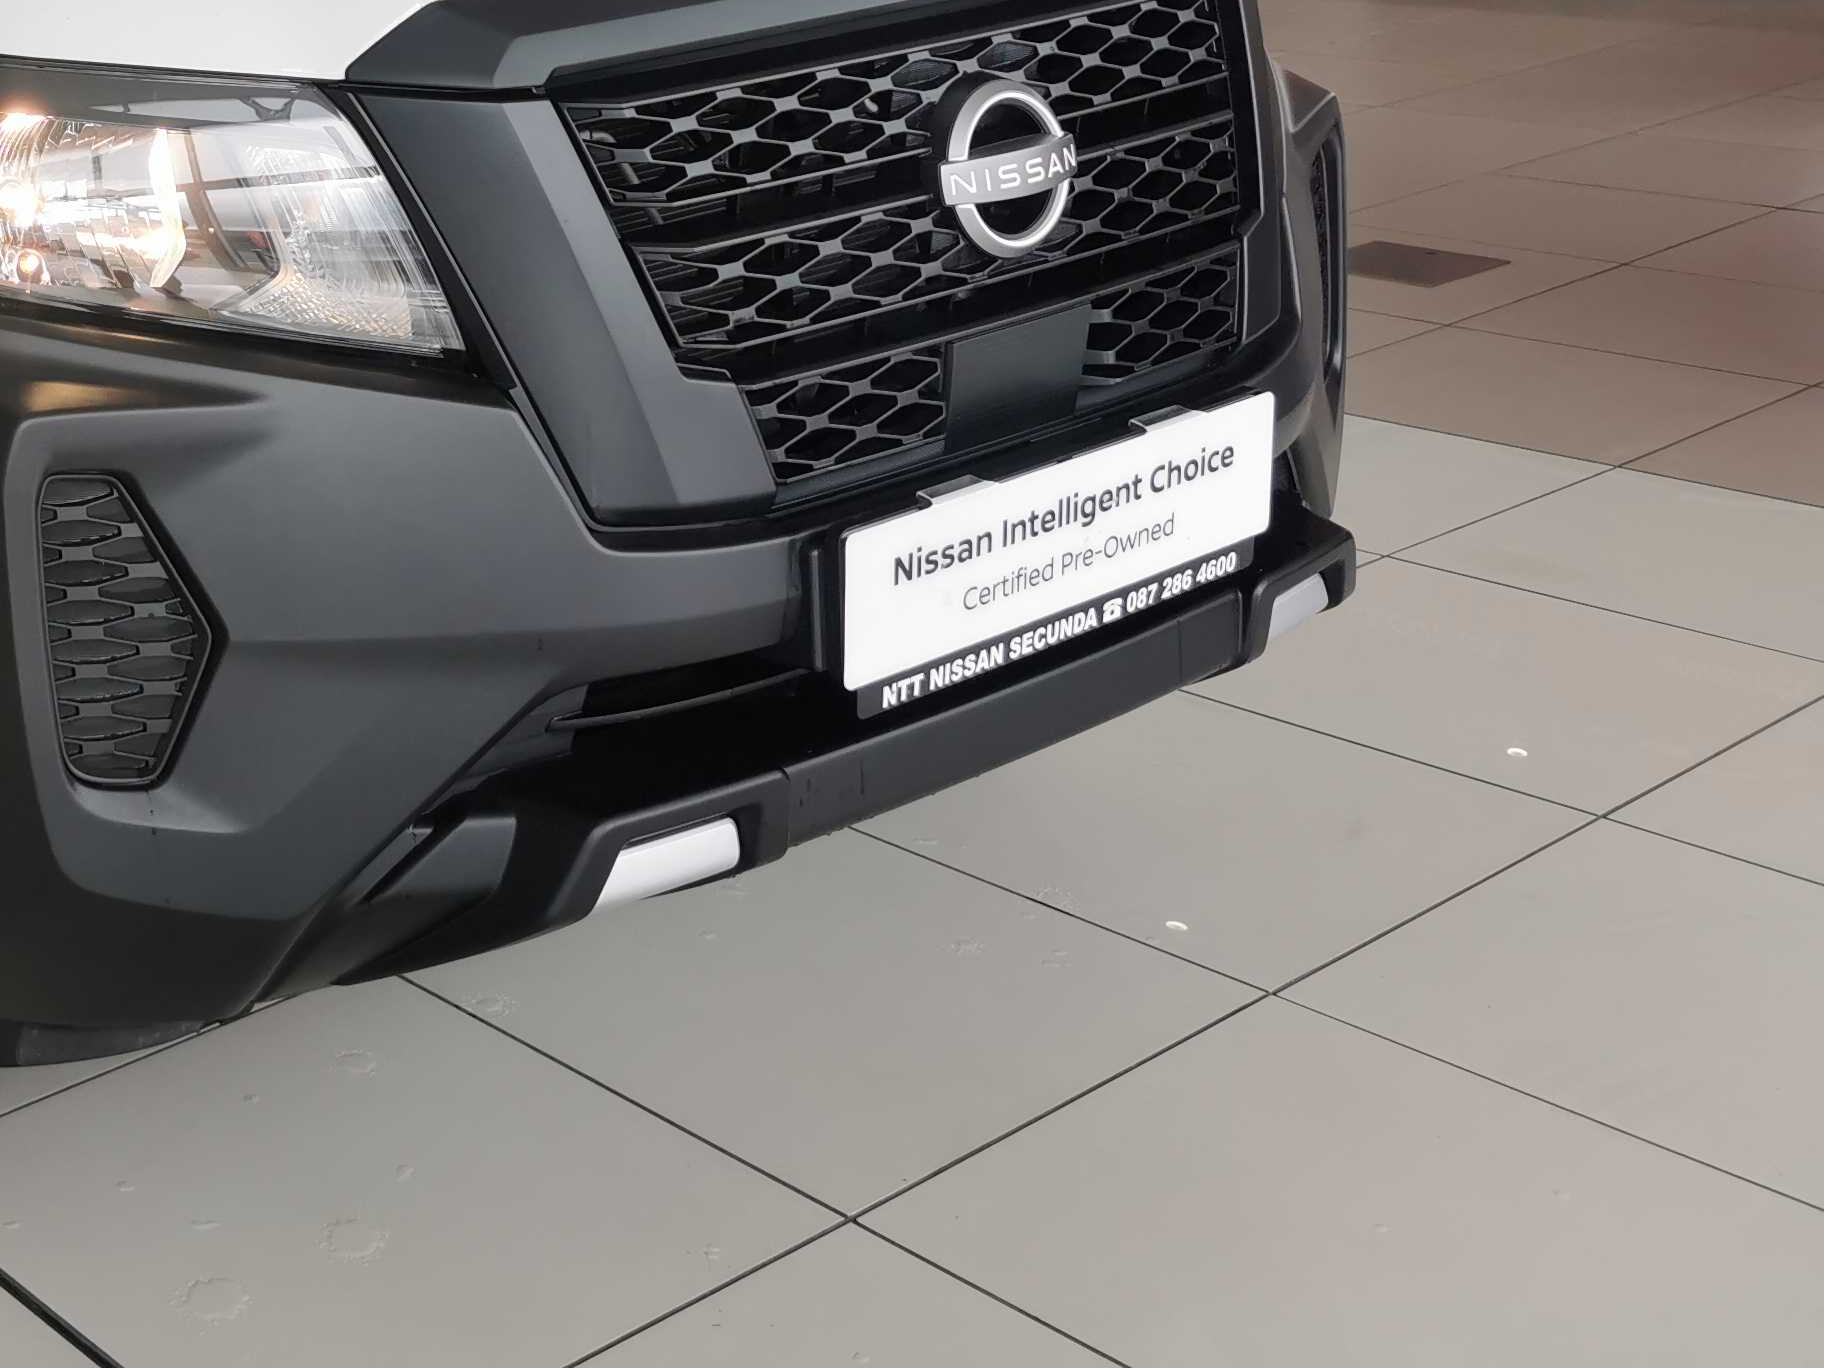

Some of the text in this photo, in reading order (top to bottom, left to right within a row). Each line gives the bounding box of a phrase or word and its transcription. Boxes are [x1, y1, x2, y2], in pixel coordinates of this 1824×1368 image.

[949, 143, 1076, 196] NISSAN
[893, 442, 1235, 586] Nissan Intelligent Choice
[962, 512, 1175, 611] Certified Pre-Owned
[882, 551, 1238, 709] NTT NISSAN SECUNDA 087 286 4600
